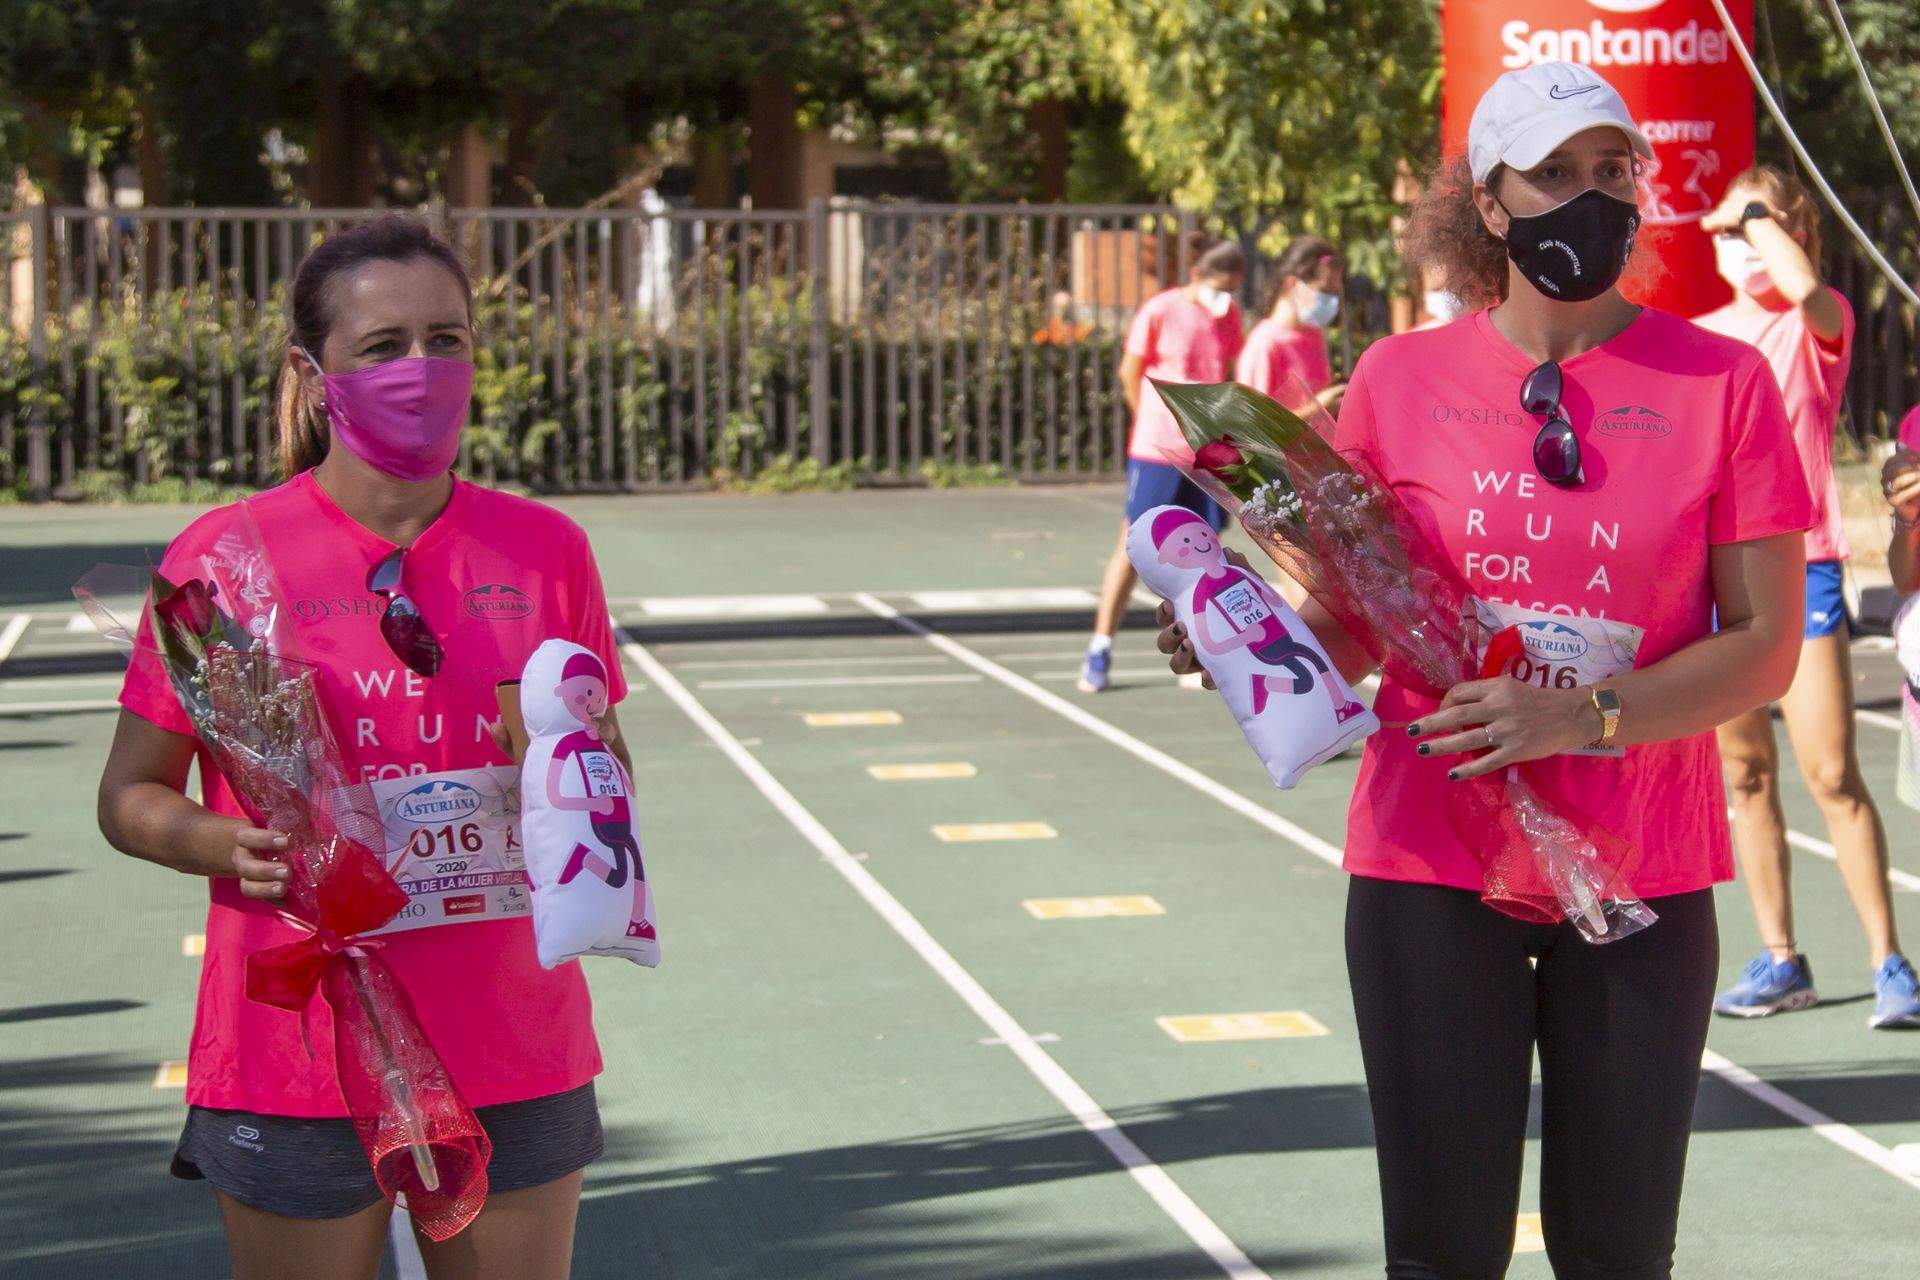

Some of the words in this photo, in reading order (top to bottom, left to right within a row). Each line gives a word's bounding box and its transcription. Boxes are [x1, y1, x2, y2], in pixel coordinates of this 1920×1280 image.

[1501, 19, 1729, 68] Santander
[1641, 120, 1715, 143] correr
[1432, 404, 1524, 427] OYSHO
[1600, 418, 1667, 433] ASTURIANA
[1472, 470, 1537, 498] WE
[1466, 552, 1533, 584] FOR
[1585, 564, 1611, 593] A
[1243, 608, 1264, 625] 016
[1524, 634, 1582, 654] STURIANA
[353, 669, 424, 699] WE
[1510, 655, 1579, 690] 016
[599, 784, 618, 795] 016
[402, 798, 476, 817] ASTURIANA
[409, 822, 484, 859] 016
[435, 860, 468, 874] 2020
[420, 880, 438, 893] DE
[440, 879, 456, 890] LA
[457, 874, 494, 888] MUJER
